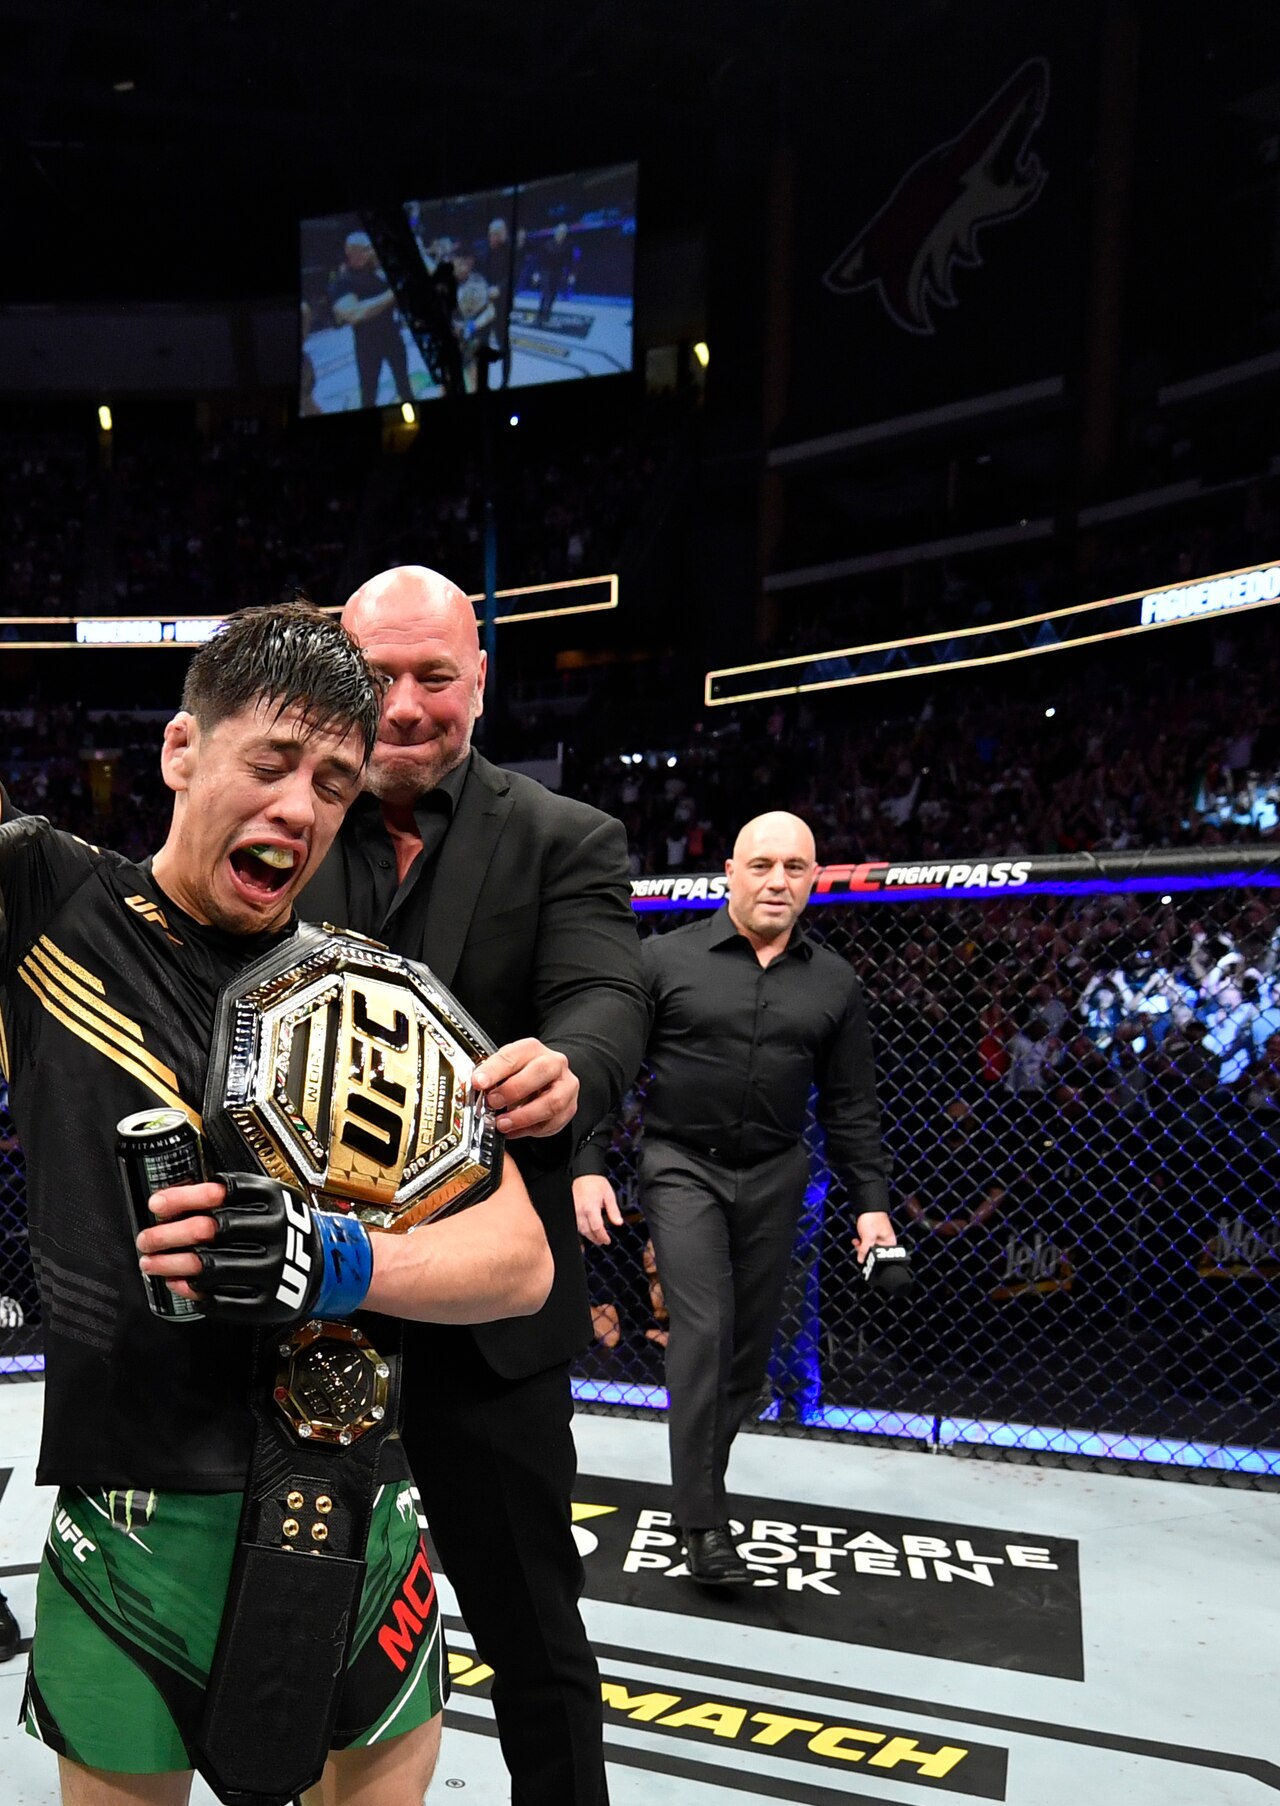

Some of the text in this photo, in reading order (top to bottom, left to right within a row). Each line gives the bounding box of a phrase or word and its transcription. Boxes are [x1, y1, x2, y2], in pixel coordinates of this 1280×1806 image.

[670, 876, 731, 901] PAS
[812, 861, 1032, 893] FC FIGHT PASS
[340, 989, 410, 1167] UFC
[275, 1189, 312, 1310] UFC
[55, 1508, 97, 1563] UFC
[629, 1529, 996, 1588] POTEIN
[378, 1533, 436, 1673] MO
[601, 1683, 969, 1779] MATCH
